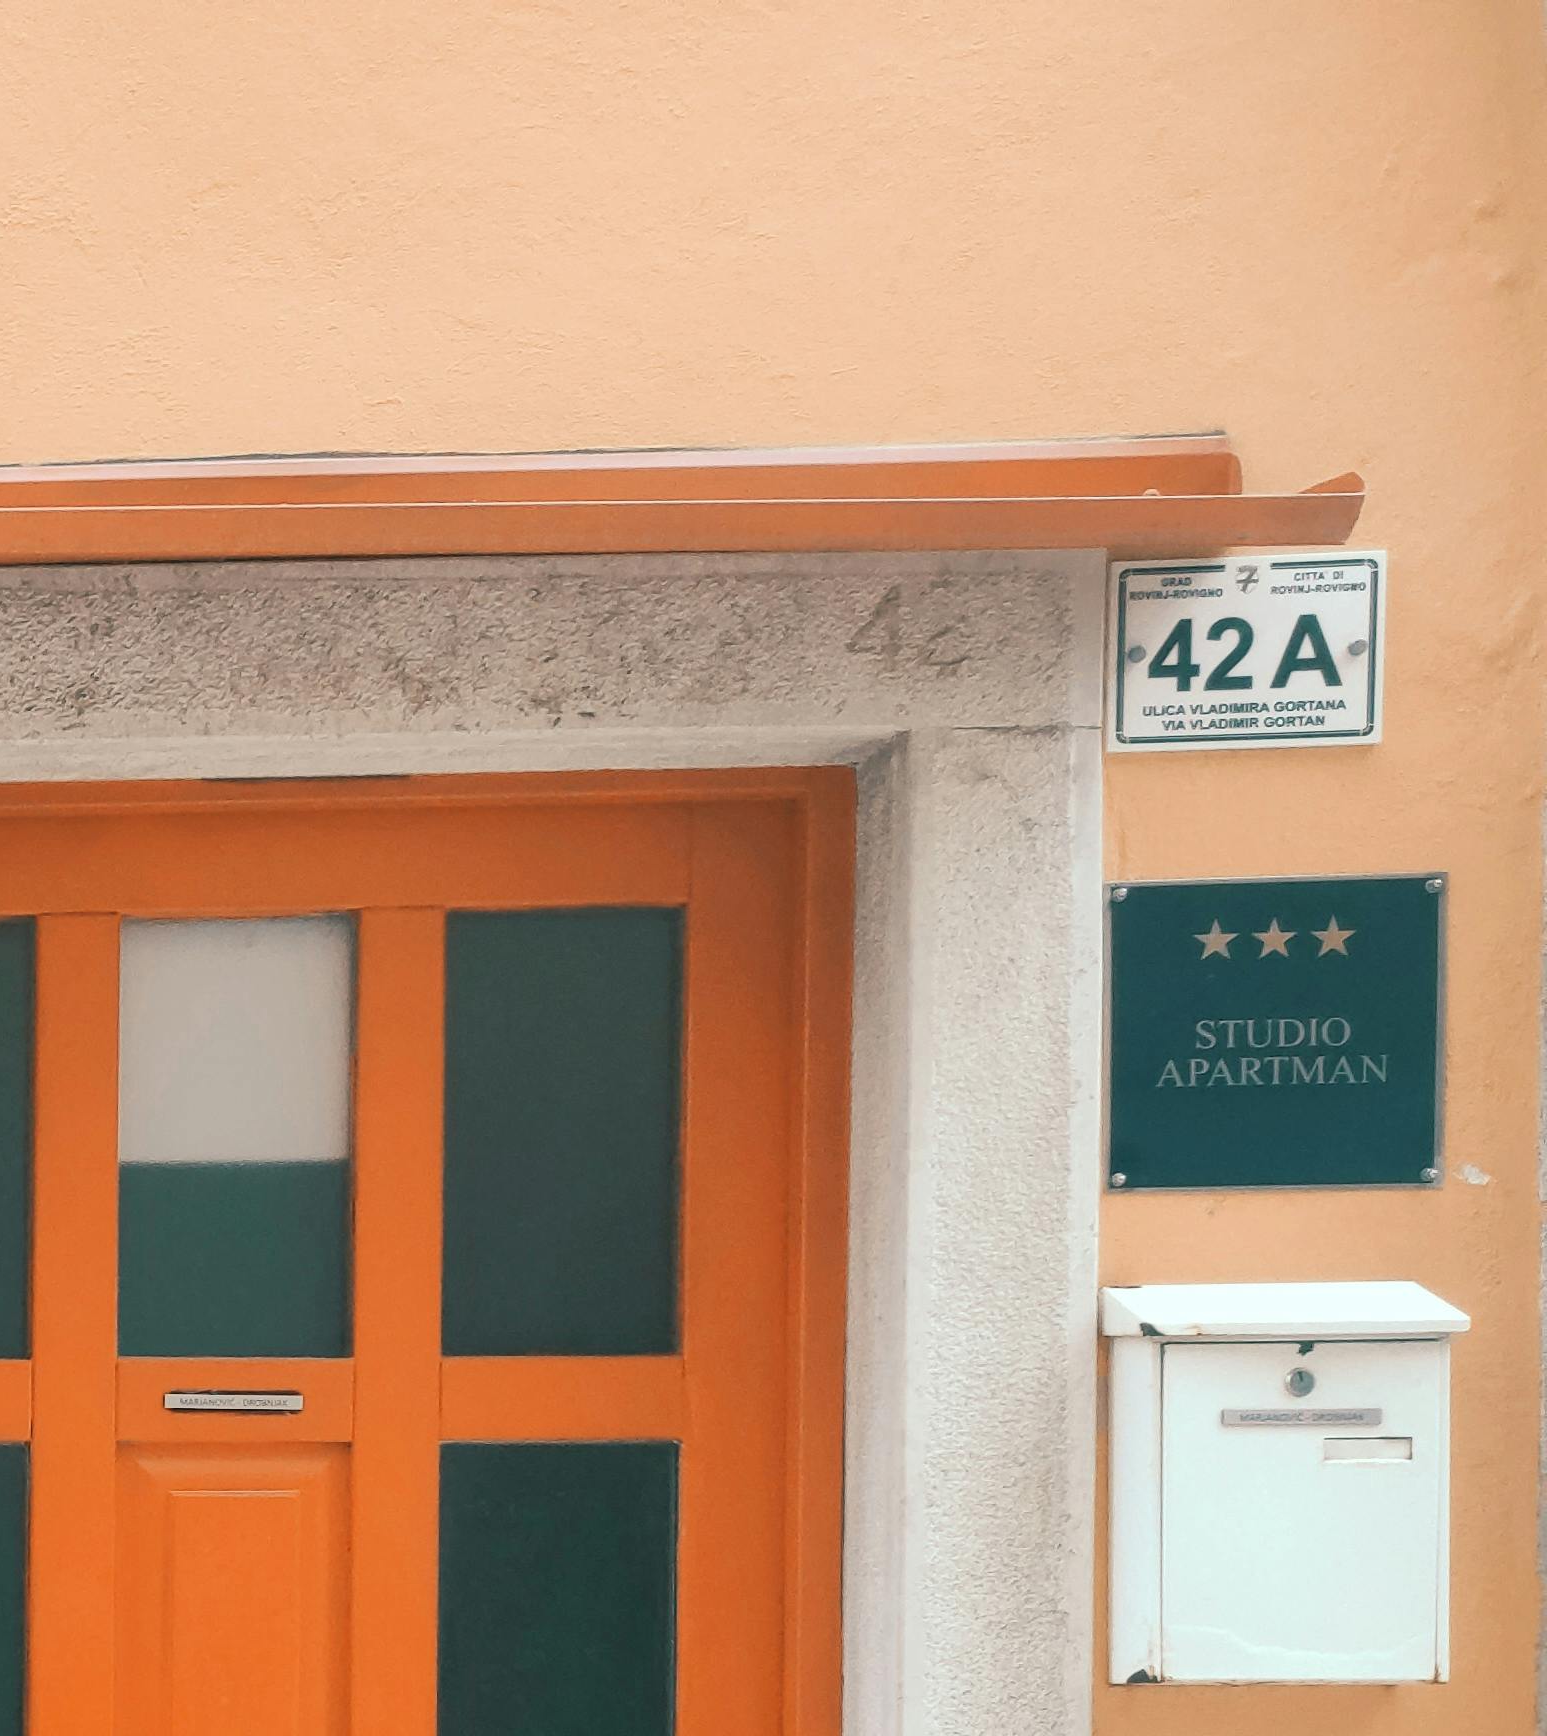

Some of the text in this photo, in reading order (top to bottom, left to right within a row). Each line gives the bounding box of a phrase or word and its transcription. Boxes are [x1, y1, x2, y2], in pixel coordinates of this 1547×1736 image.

[1161, 577, 1192, 587] GRAD
[1333, 571, 1344, 580] DI
[1270, 582, 1367, 595] ROVINJ-ROVIGNO
[1147, 613, 1343, 692] 42 A
[1142, 699, 1347, 717] ULICA VLADIMIRA GORTANA
[1162, 715, 1326, 731] VIA VLADIMIR GORTAN
[1194, 1017, 1352, 1050] STUDIO
[1155, 1054, 1391, 1089] APARTMAN
